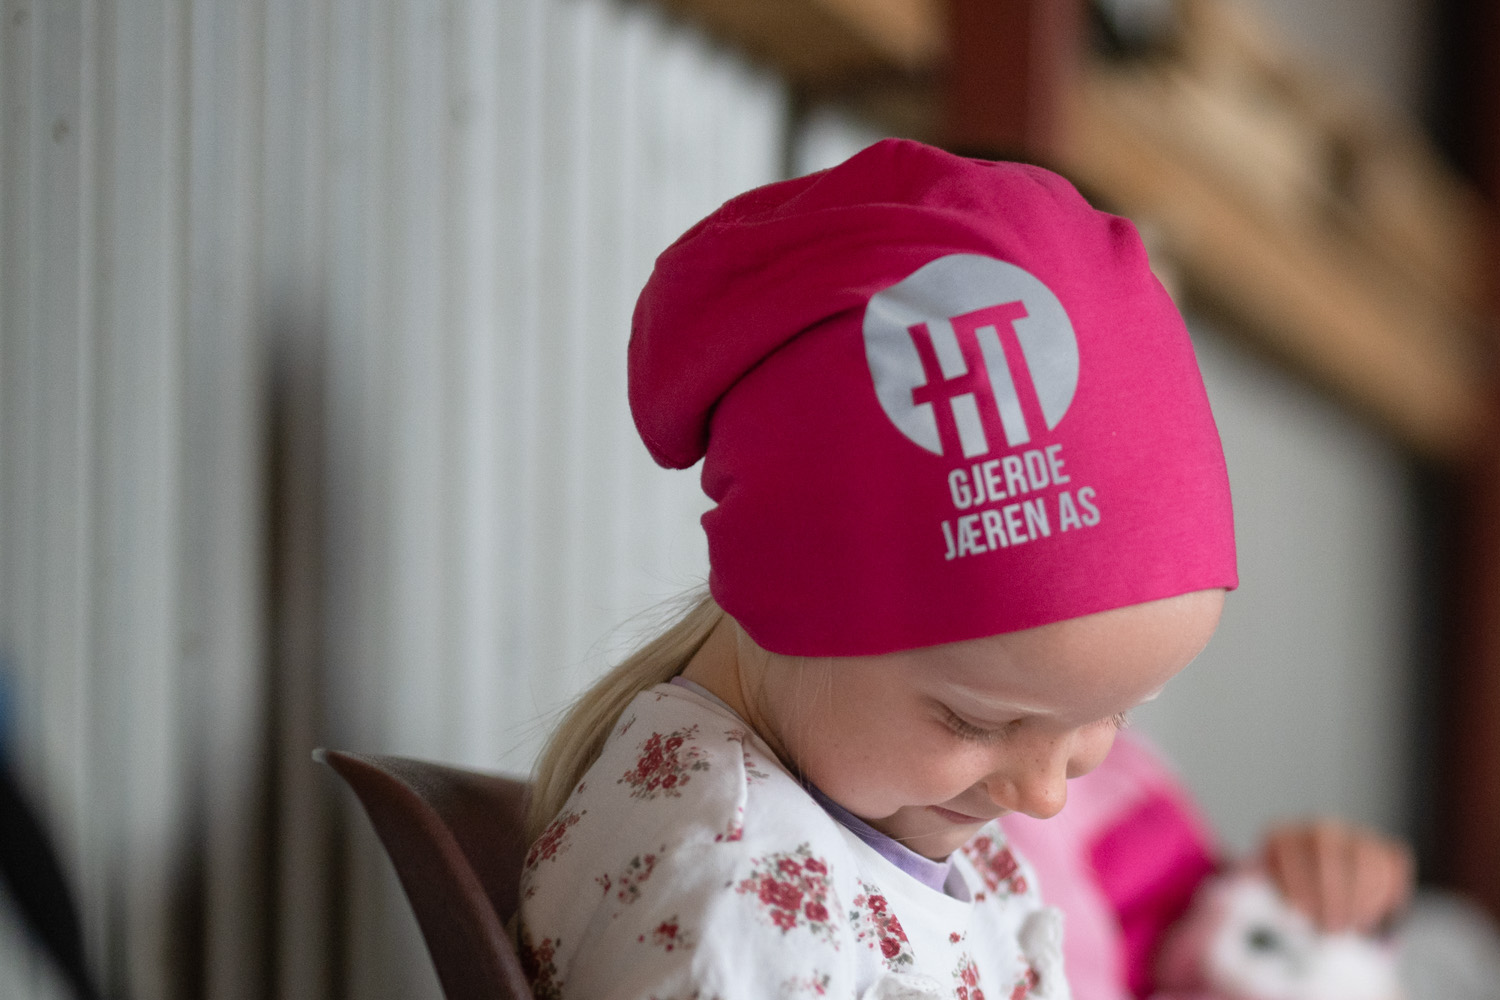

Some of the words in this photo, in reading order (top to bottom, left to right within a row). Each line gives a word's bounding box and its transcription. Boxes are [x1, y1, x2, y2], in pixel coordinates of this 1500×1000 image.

[948, 444, 1070, 509] GJERDE
[941, 498, 1051, 560] JÆREN
[1060, 486, 1100, 531] AS
